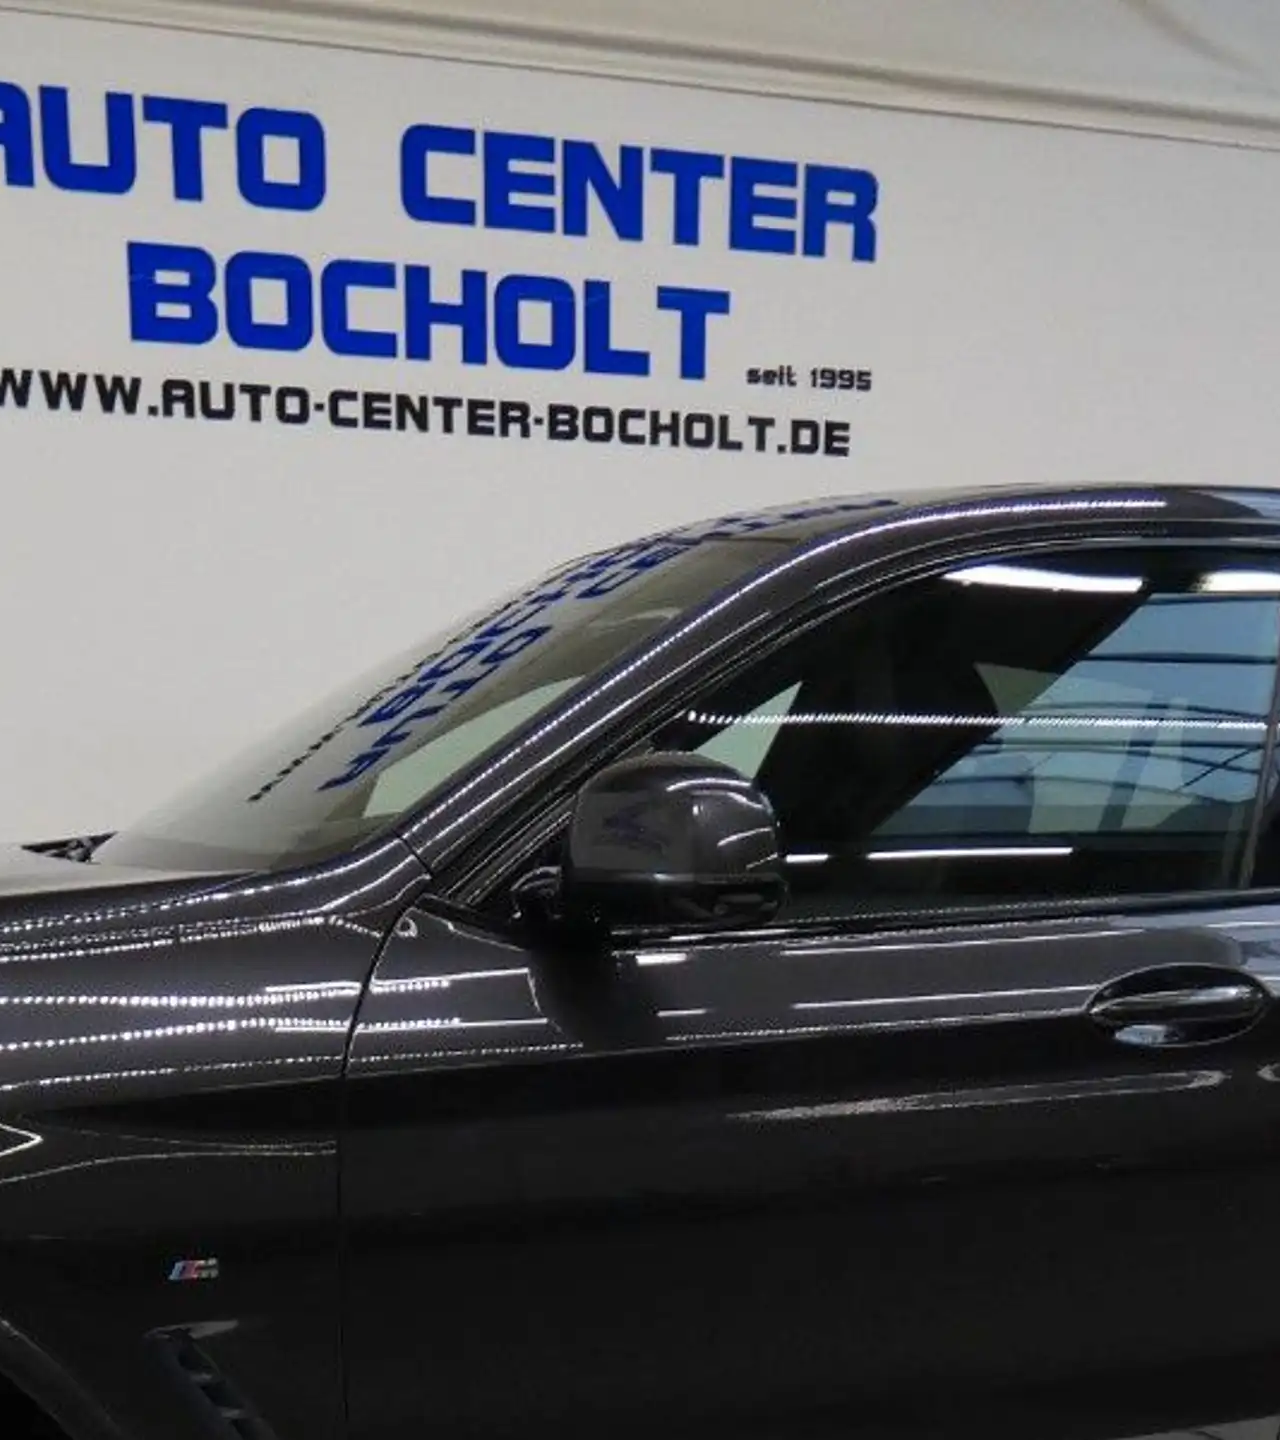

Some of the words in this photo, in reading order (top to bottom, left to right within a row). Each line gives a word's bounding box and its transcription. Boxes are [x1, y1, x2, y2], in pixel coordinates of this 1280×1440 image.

[401, 124, 878, 262] CENTER
[127, 242, 730, 380] BOCHOLT
[746, 365, 797, 387] seit
[810, 367, 872, 392] 1995
